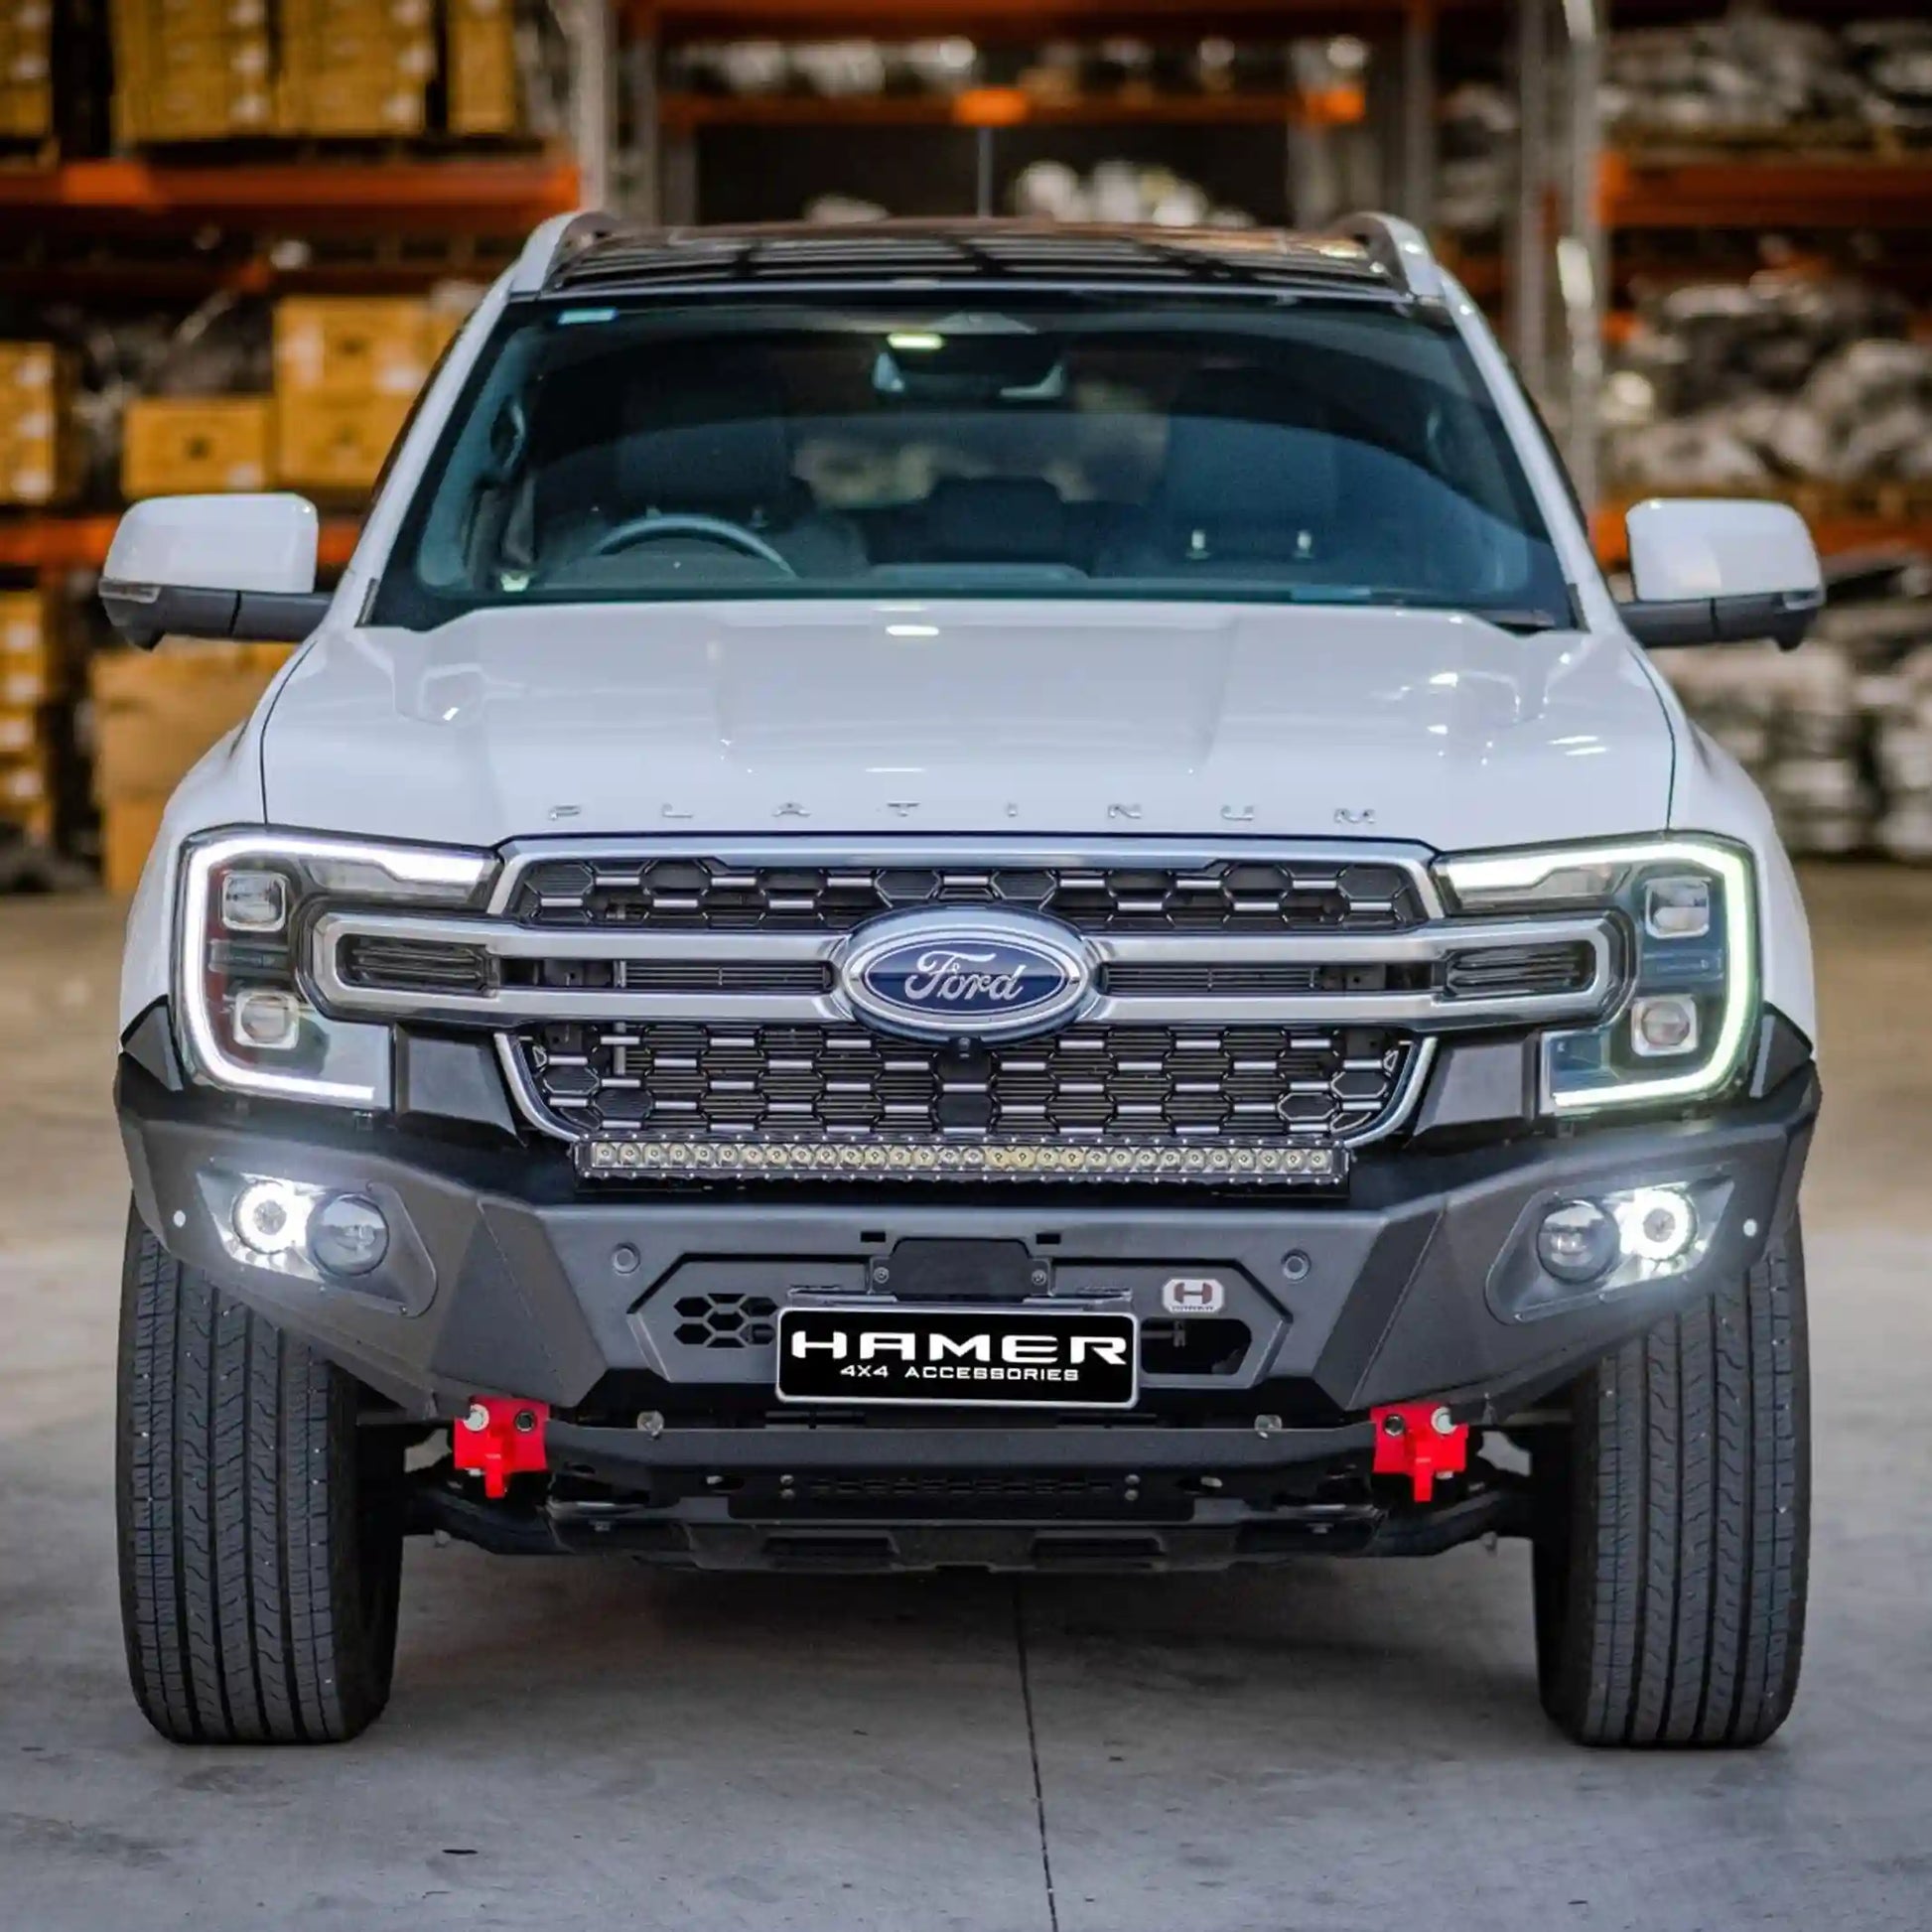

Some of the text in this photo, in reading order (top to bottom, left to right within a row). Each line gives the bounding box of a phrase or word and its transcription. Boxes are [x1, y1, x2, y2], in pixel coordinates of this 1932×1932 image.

[548, 801, 1376, 825] PLATINUM
[904, 950, 1027, 1001] Ford
[1173, 1282, 1213, 1305] H
[791, 1330, 1128, 1365] HAMER
[904, 1366, 1079, 1382] ACCESSORIES
